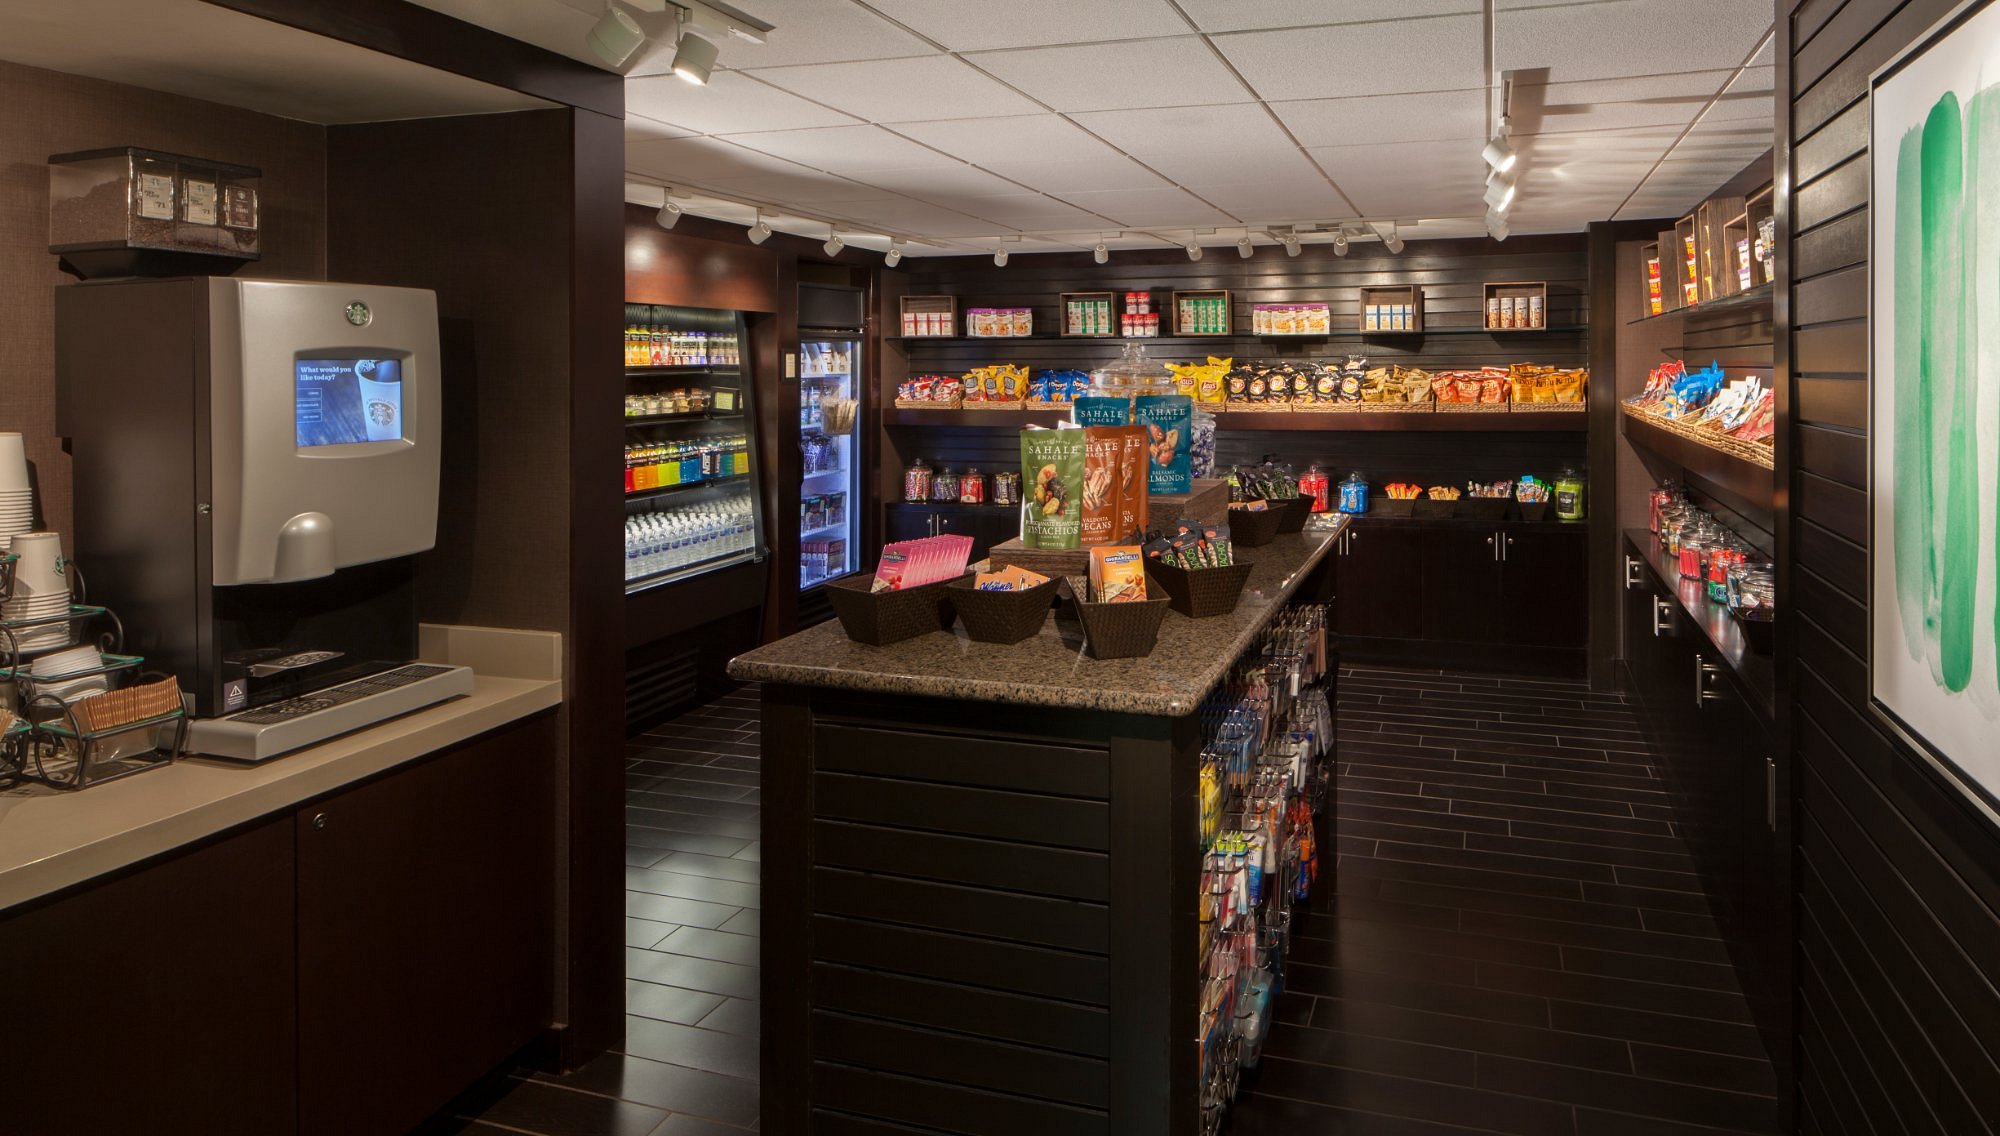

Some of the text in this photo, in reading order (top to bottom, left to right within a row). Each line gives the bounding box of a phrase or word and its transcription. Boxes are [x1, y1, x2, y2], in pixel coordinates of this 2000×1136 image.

[1081, 410, 1124, 418] SAHALE
[1141, 408, 1186, 416] SAHALE
[1028, 445, 1079, 454] SAHALE
[1085, 442, 1118, 452] HALE
[1147, 474, 1185, 483] LMONDS
[1027, 526, 1079, 535] PISTACHIOS
[1215, 540, 1229, 567] TACHIOS
